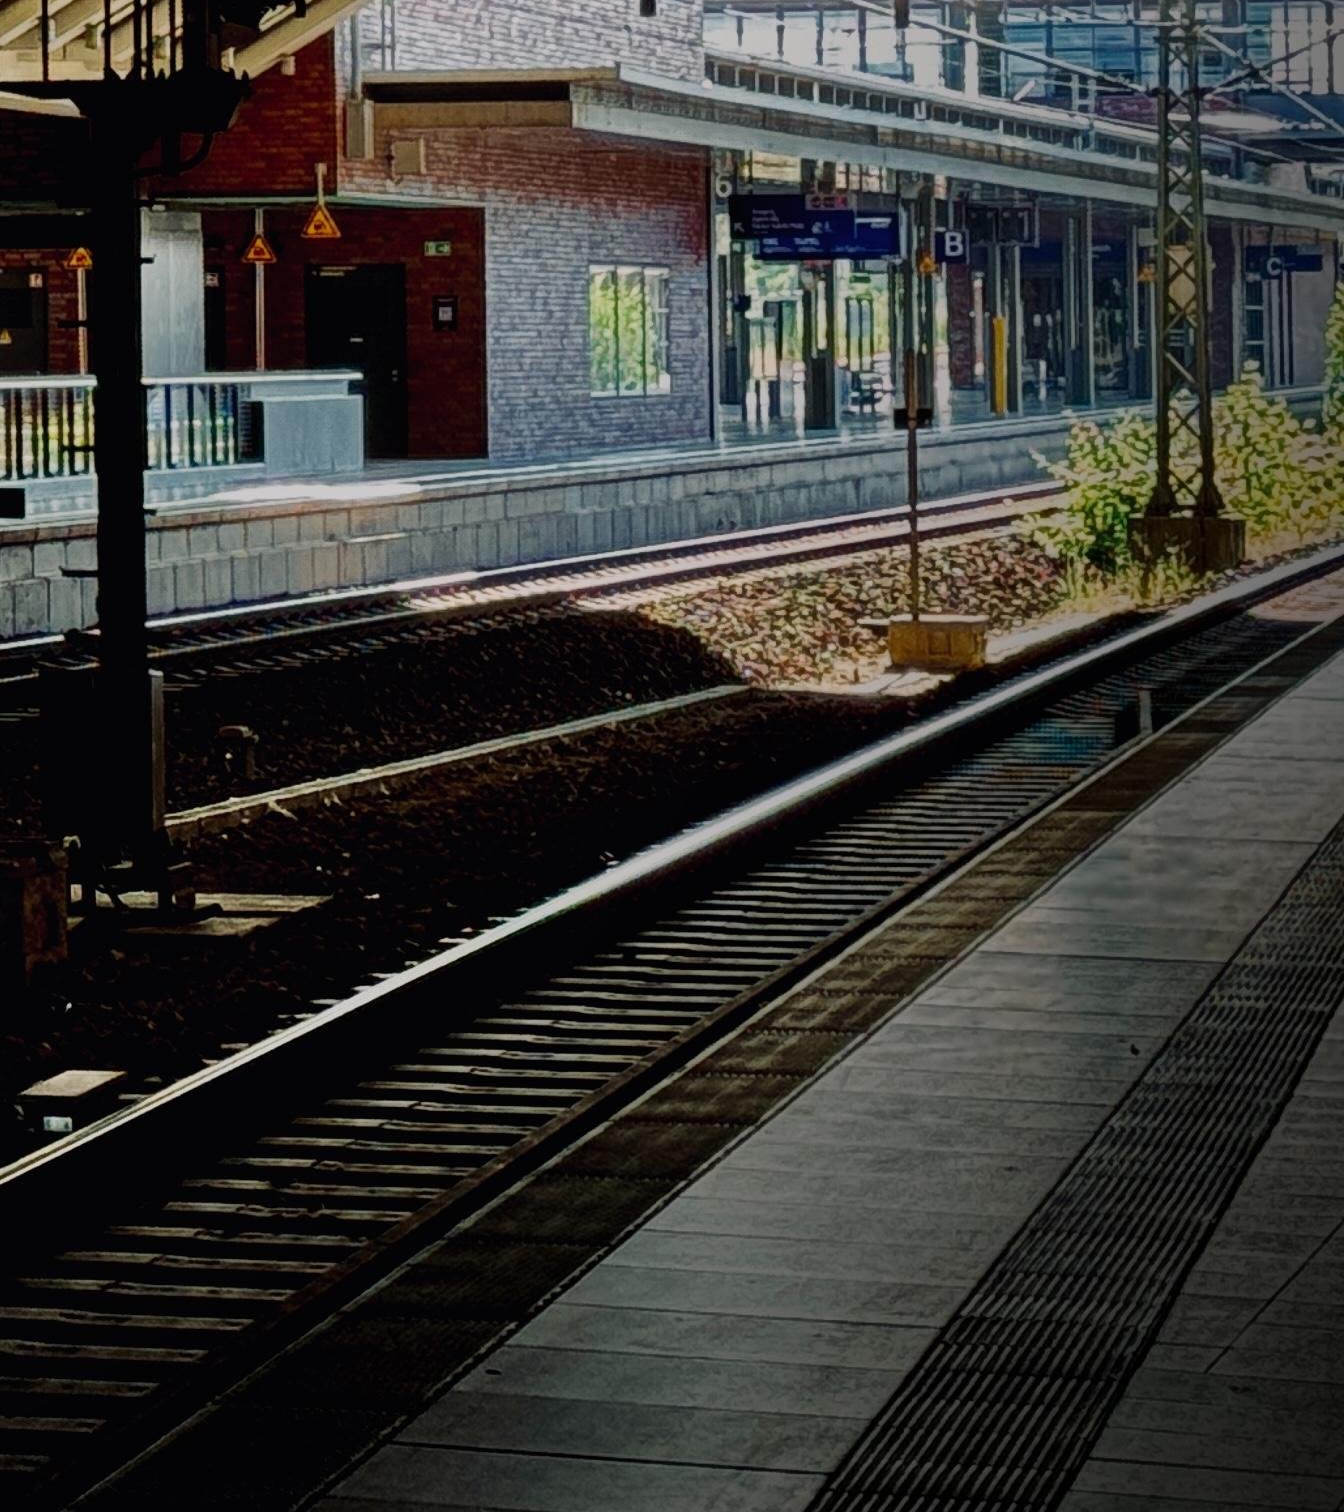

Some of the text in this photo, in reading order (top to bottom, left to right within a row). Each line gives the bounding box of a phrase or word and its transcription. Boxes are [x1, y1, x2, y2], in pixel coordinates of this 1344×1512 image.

[715, 173, 732, 198] 6
[944, 231, 965, 257] B
[1266, 257, 1282, 275] C
